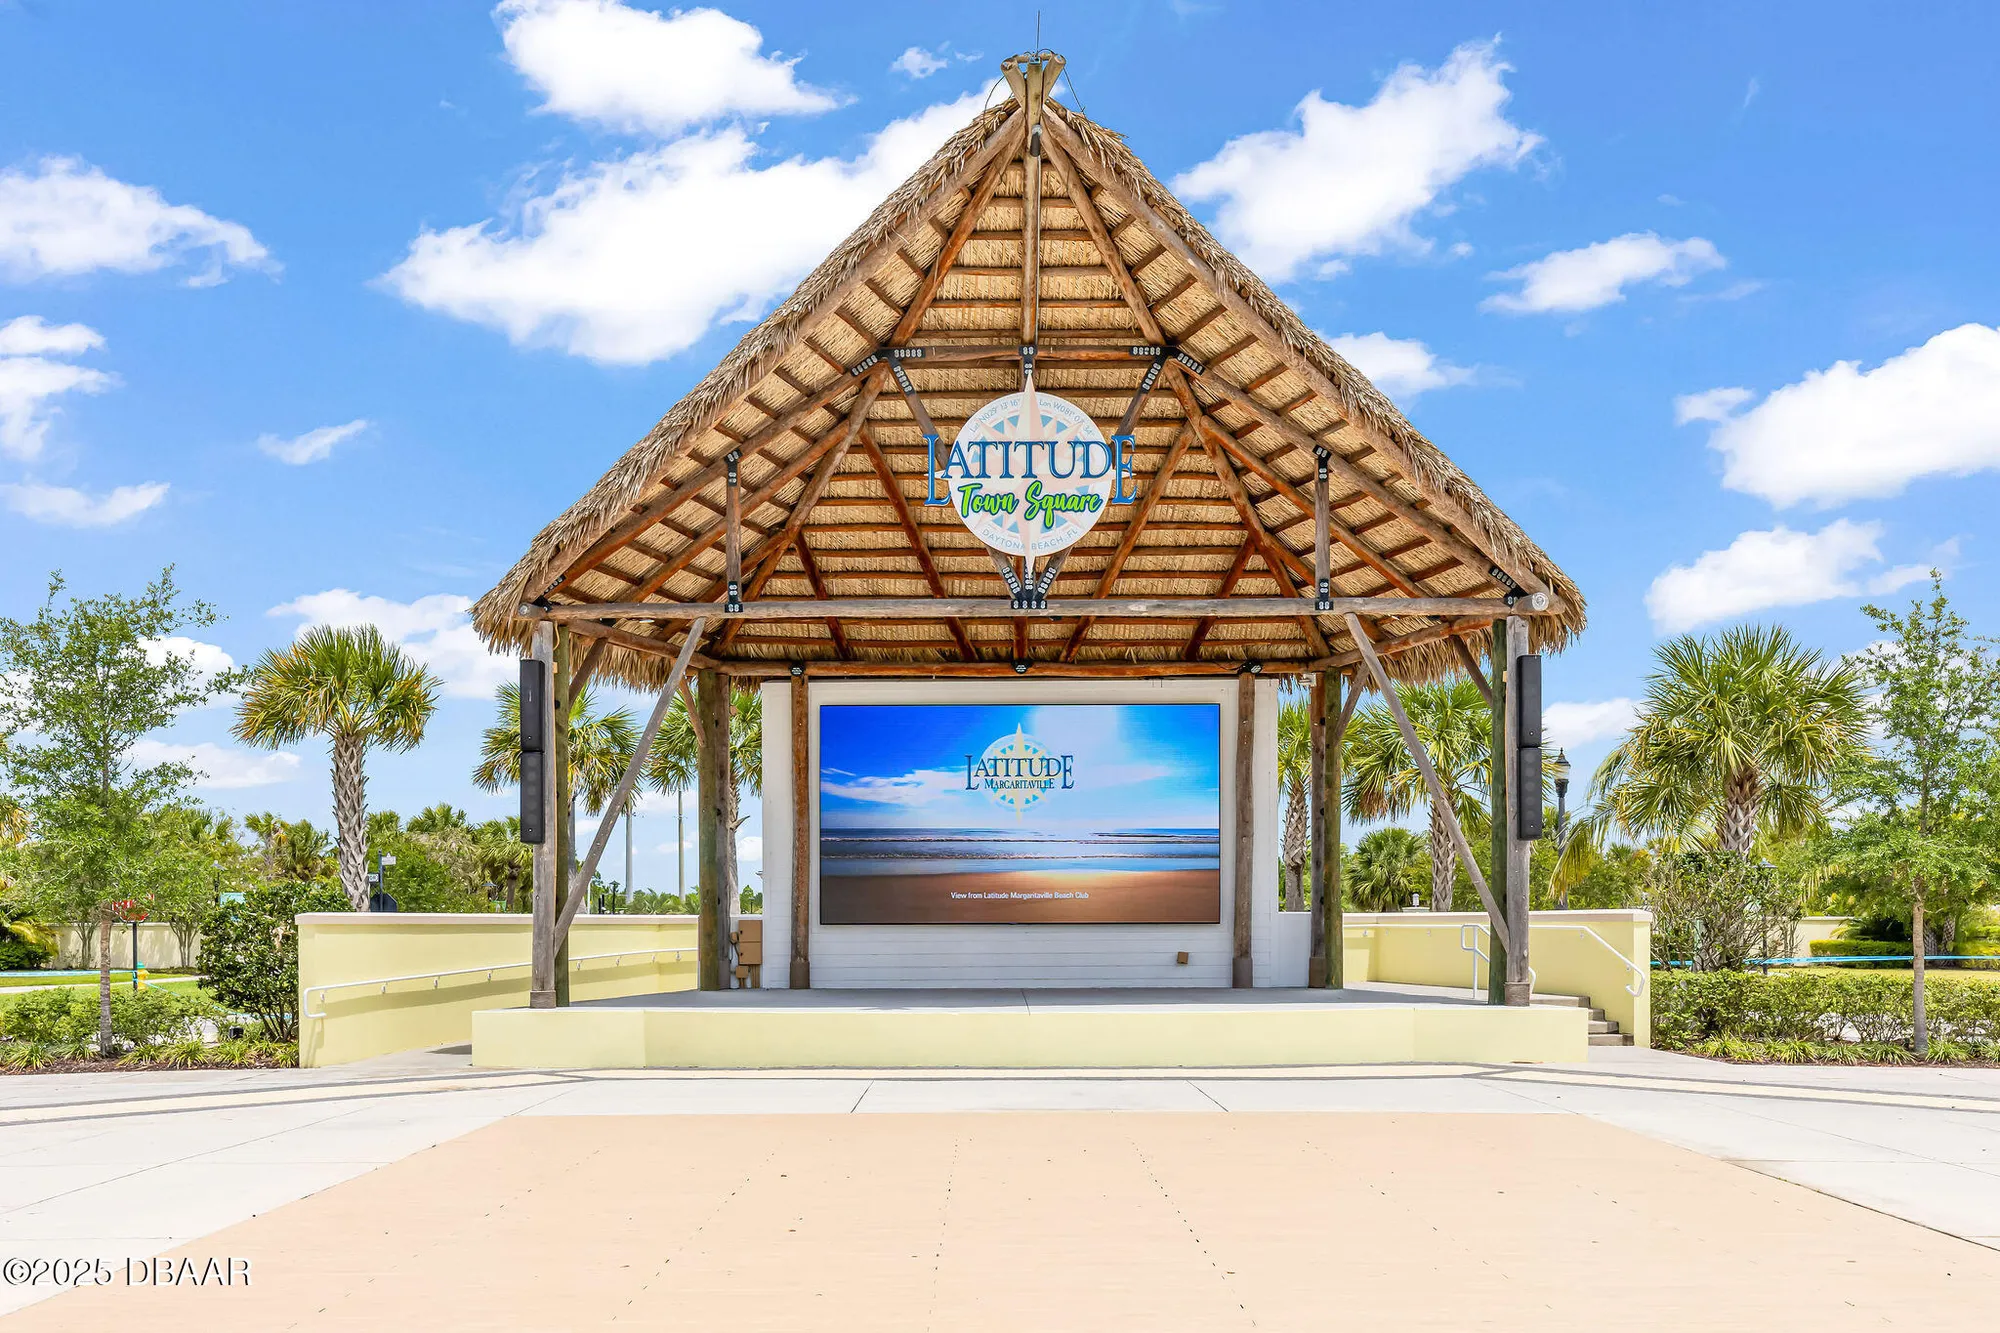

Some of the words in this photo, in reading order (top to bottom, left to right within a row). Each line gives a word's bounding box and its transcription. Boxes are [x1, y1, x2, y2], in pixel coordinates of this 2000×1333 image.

[923, 434, 1138, 506] LATITUDE
[958, 483, 1019, 518] Town
[1024, 480, 1104, 529] Square
[964, 755, 1075, 791] LATITUDE
[984, 777, 1055, 790] MARGARITAVILLE
[1010, 892, 1053, 901] Margaritaville
